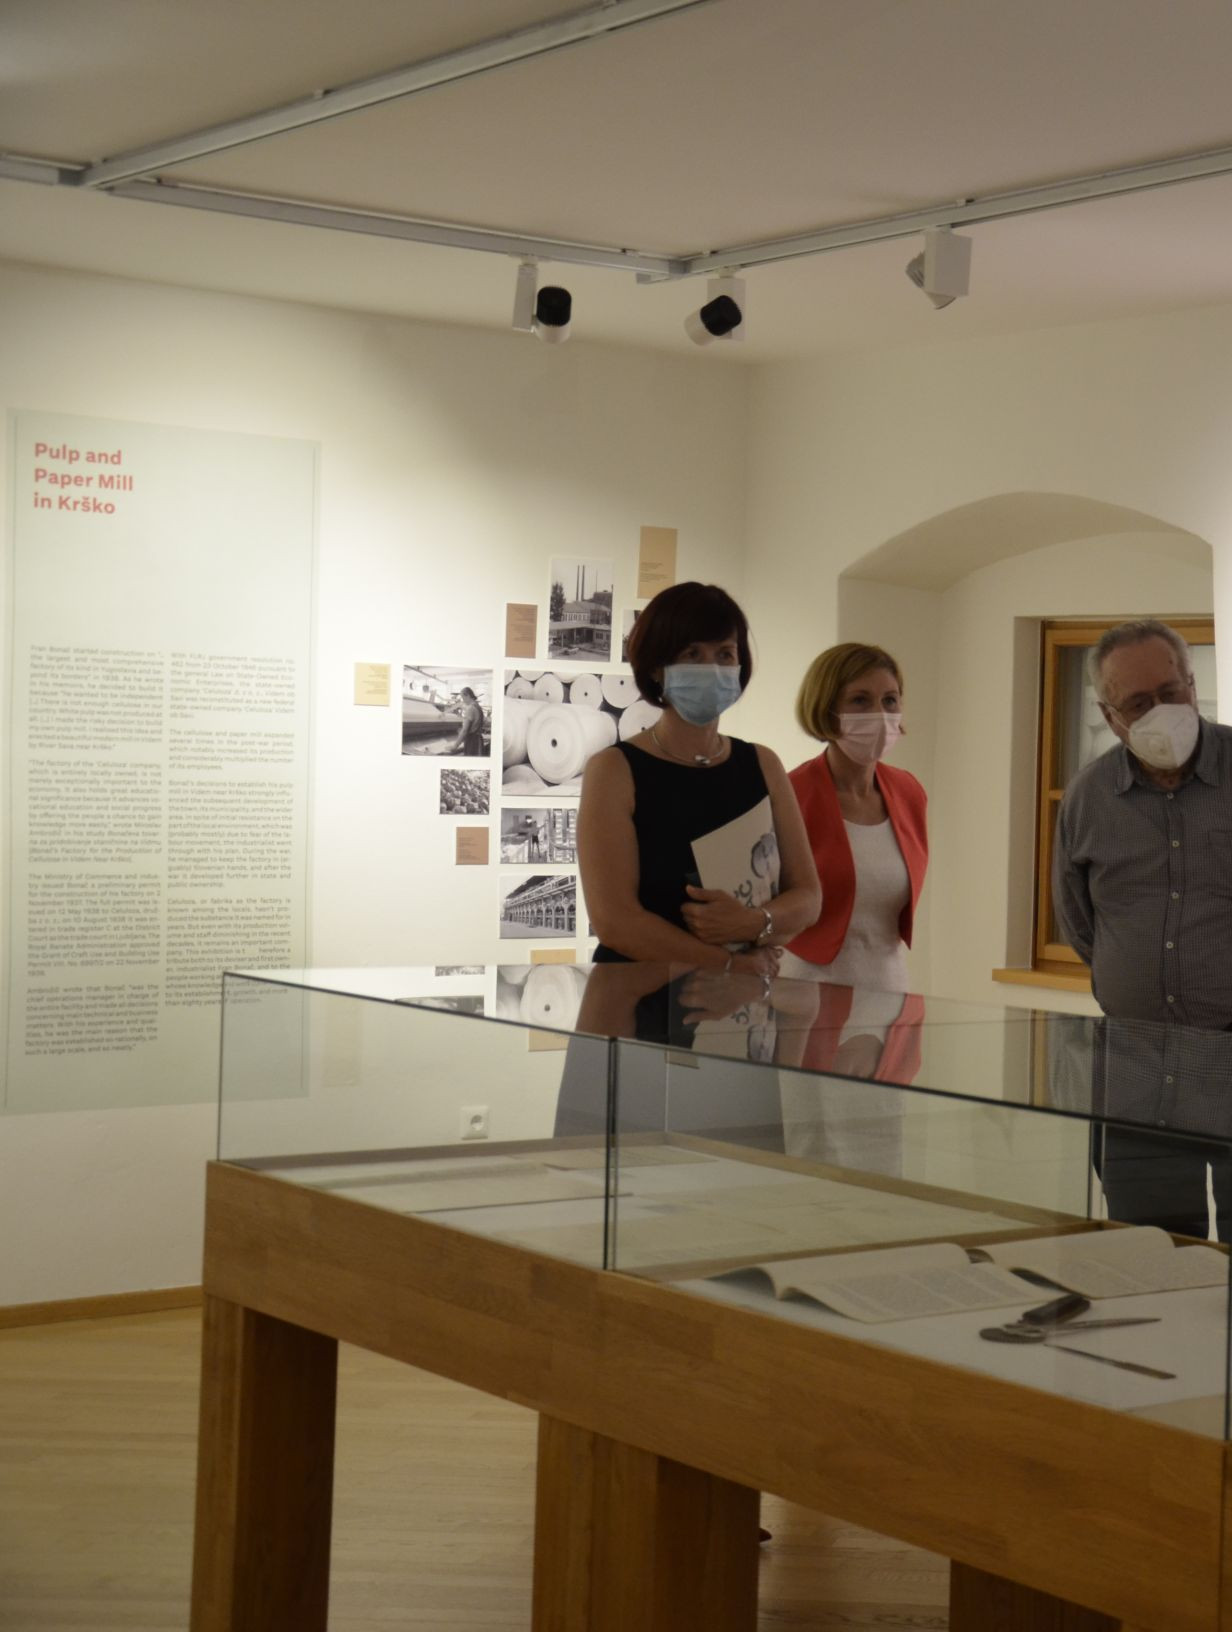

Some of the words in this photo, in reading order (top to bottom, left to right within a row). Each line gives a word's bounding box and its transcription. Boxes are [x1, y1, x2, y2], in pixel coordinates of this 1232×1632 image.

[35, 443, 80, 465] Pulp
[85, 449, 122, 466] and
[35, 468, 93, 489] Paper
[98, 474, 133, 491] Mill
[34, 492, 52, 509] in
[58, 495, 116, 514] Krško
